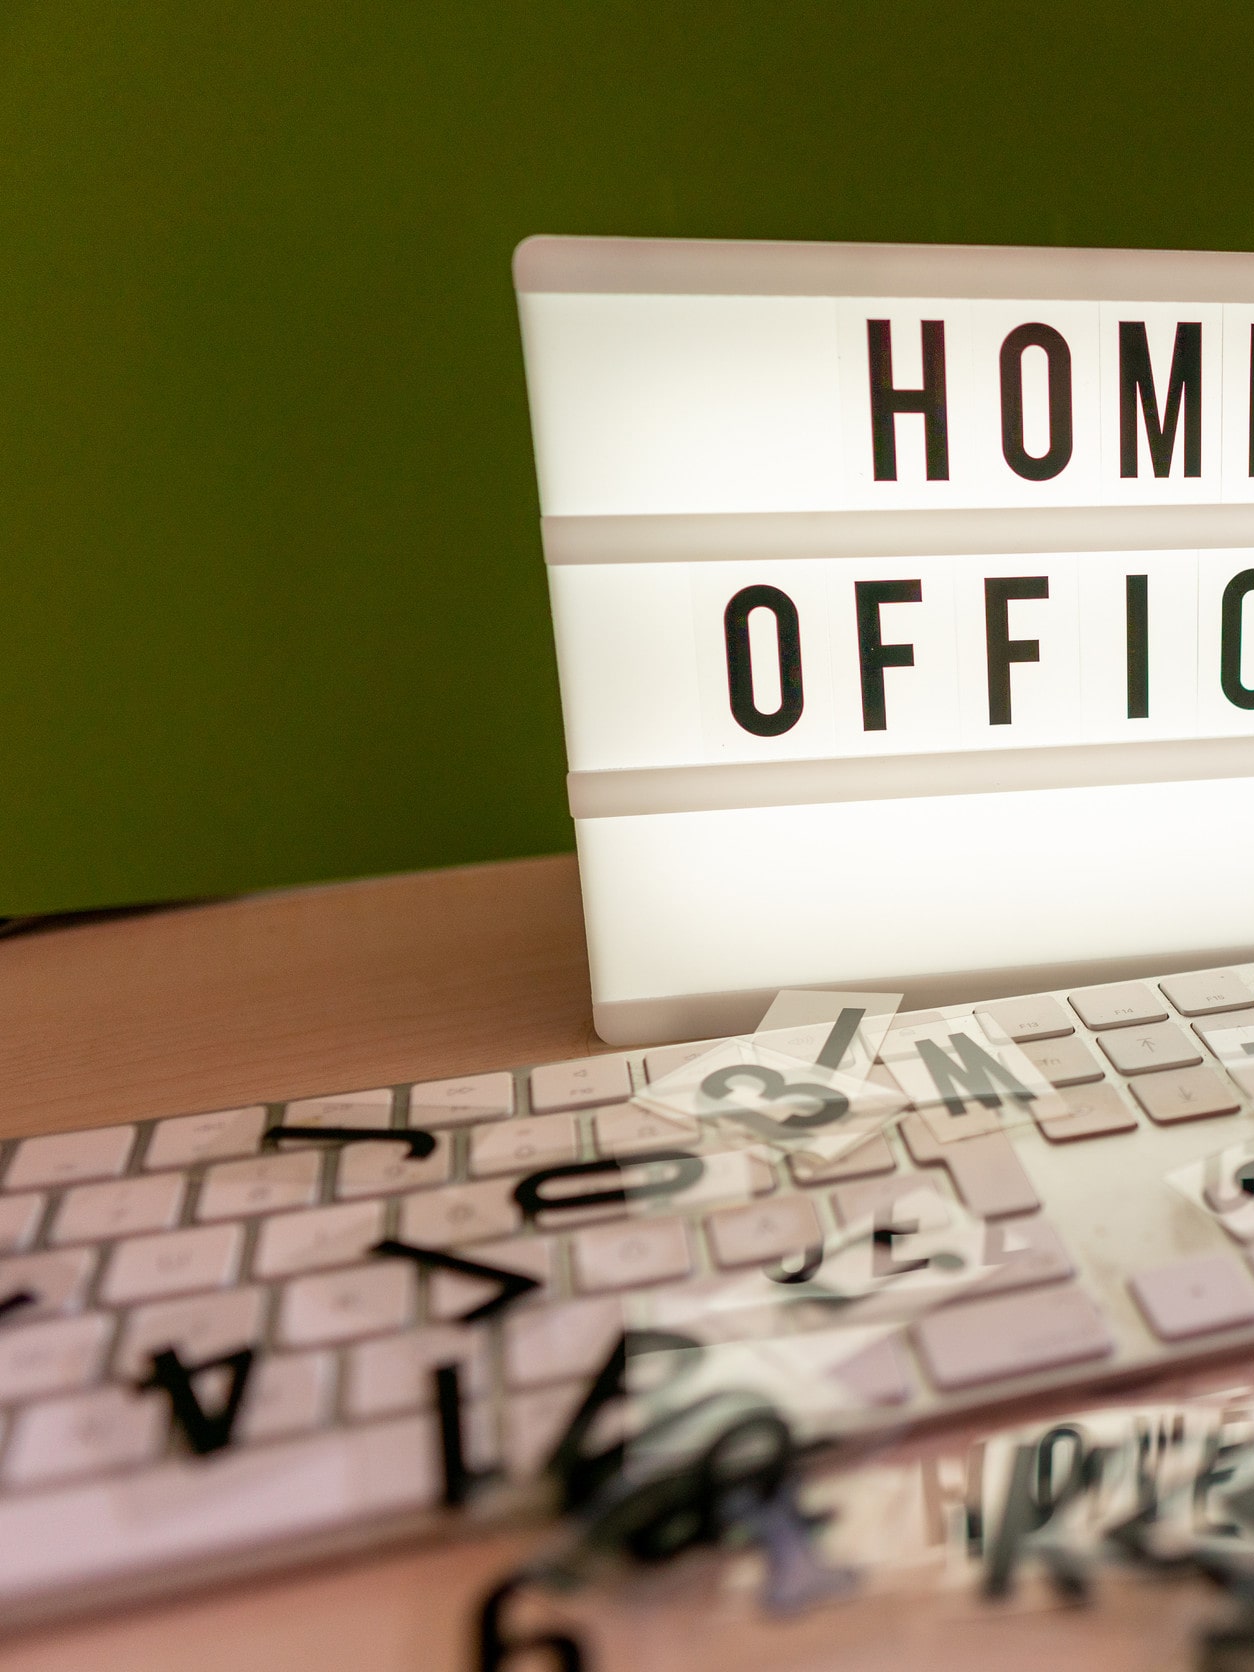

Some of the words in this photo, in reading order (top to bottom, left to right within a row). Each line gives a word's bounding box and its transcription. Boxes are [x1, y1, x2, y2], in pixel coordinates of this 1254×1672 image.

[1113, 1006, 1135, 1017] F14
[1018, 1021, 1040, 1030] F13
[913, 1031, 1038, 1117] M
